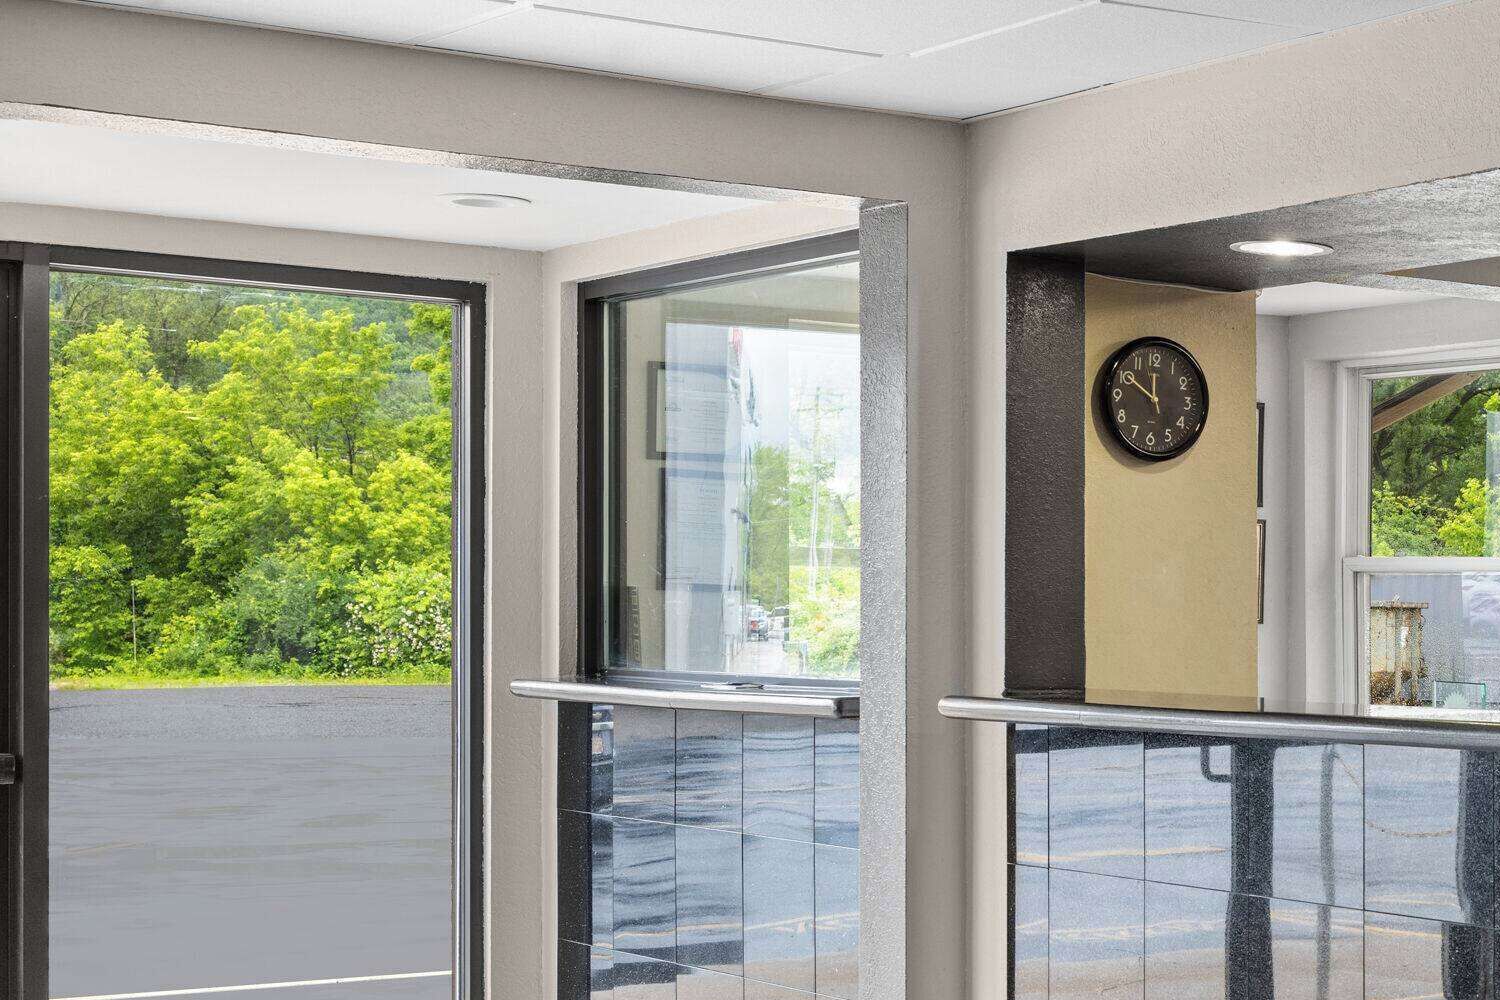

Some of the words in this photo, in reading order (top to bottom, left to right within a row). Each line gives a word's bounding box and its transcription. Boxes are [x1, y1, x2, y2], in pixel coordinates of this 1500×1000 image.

[1134, 357, 1142, 370] 11
[1149, 353, 1161, 368] 12
[1120, 371, 1134, 384] 10
[1180, 376, 1187, 390] 2
[1113, 388, 1122, 402] 9
[1184, 397, 1191, 410] 3
[1117, 409, 1126, 422] 8
[1176, 416, 1184, 429] 4
[1131, 425, 1139, 438] 7
[1164, 429, 1172, 442] 5
[1146, 432, 1155, 445] 6
